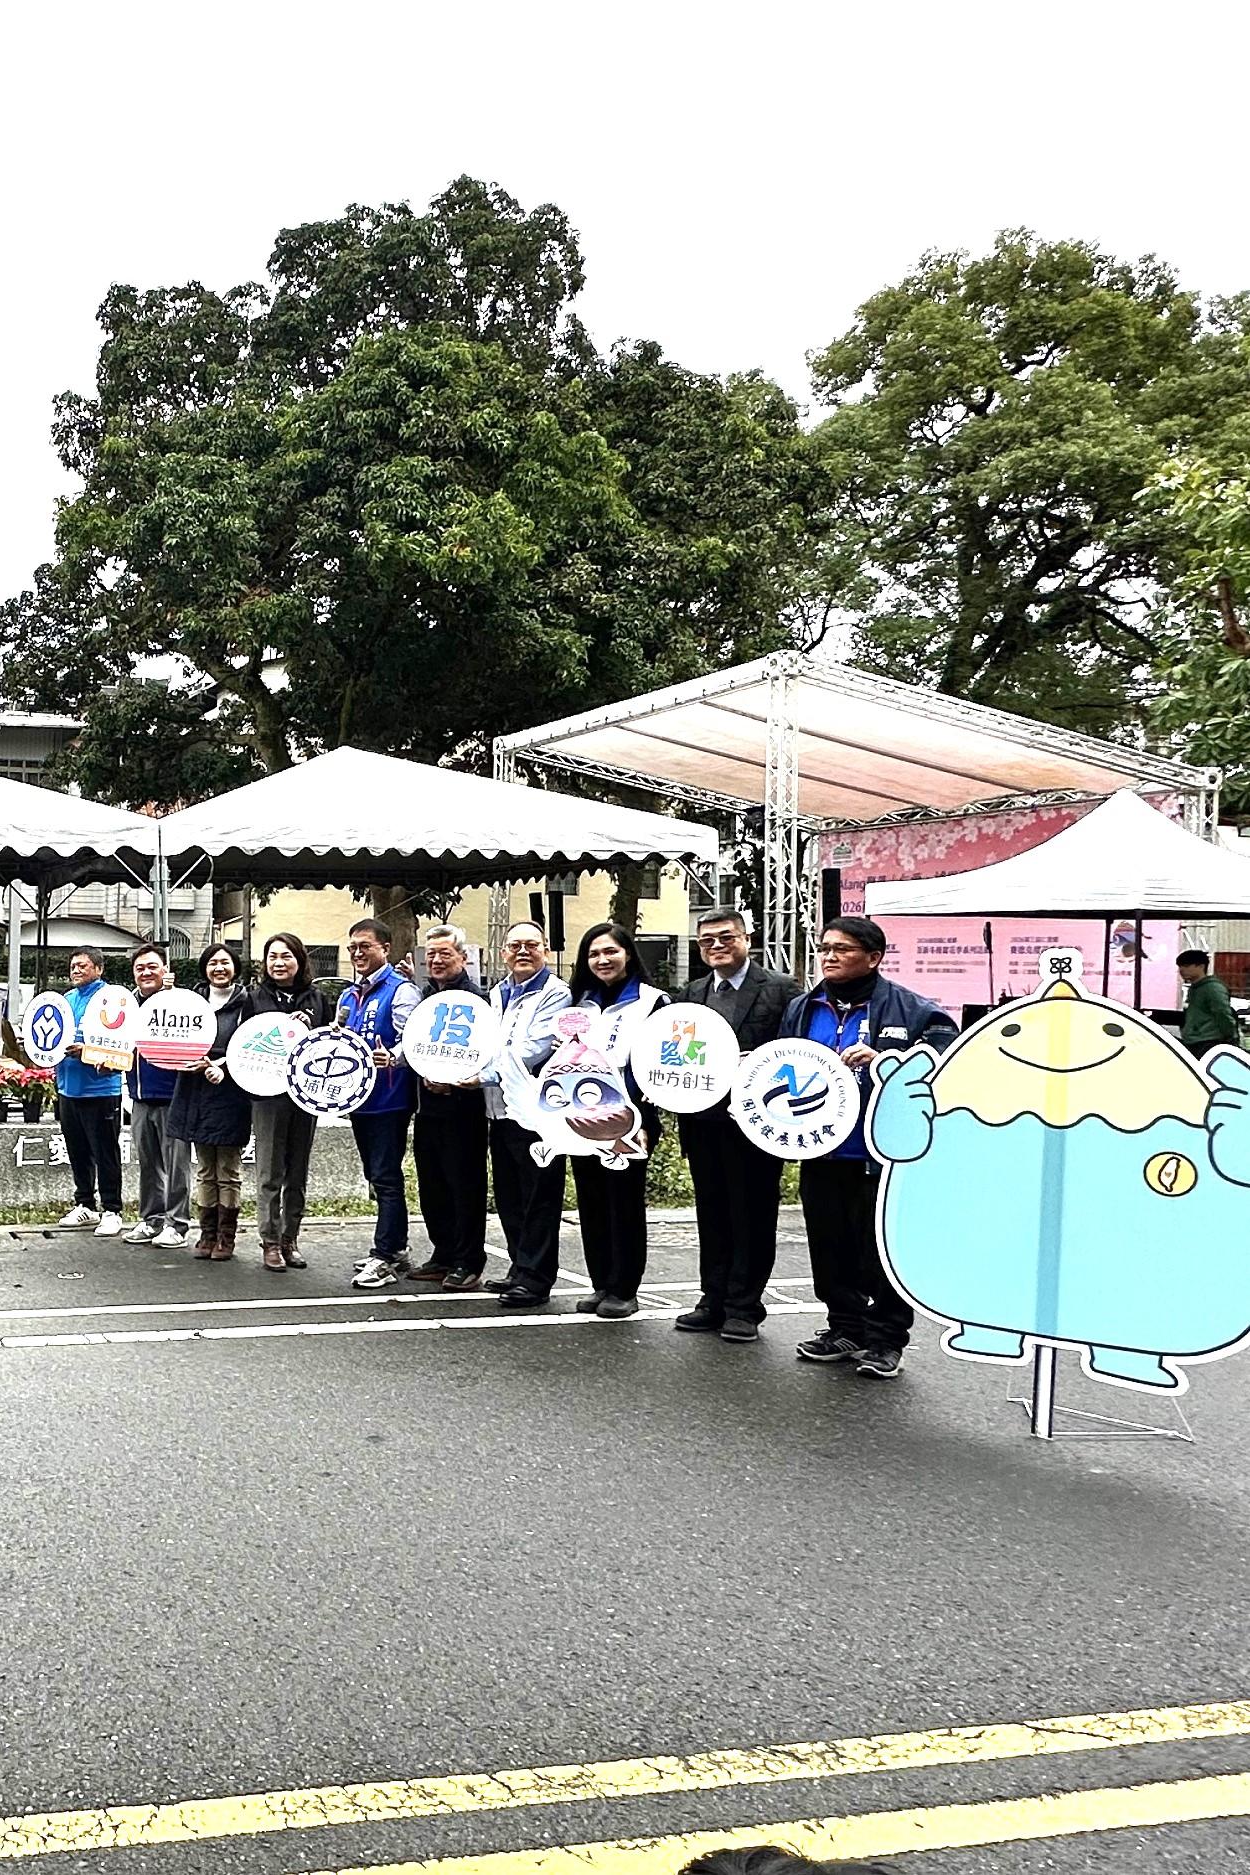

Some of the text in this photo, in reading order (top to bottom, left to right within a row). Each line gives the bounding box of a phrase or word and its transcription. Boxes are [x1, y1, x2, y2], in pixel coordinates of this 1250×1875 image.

[840, 901, 862, 913] 026
[147, 1008, 204, 1031] Alang
[412, 1042, 480, 1063] 南投縣政府
[303, 1078, 342, 1100] 埔里
[648, 1069, 716, 1092] 地方創生
